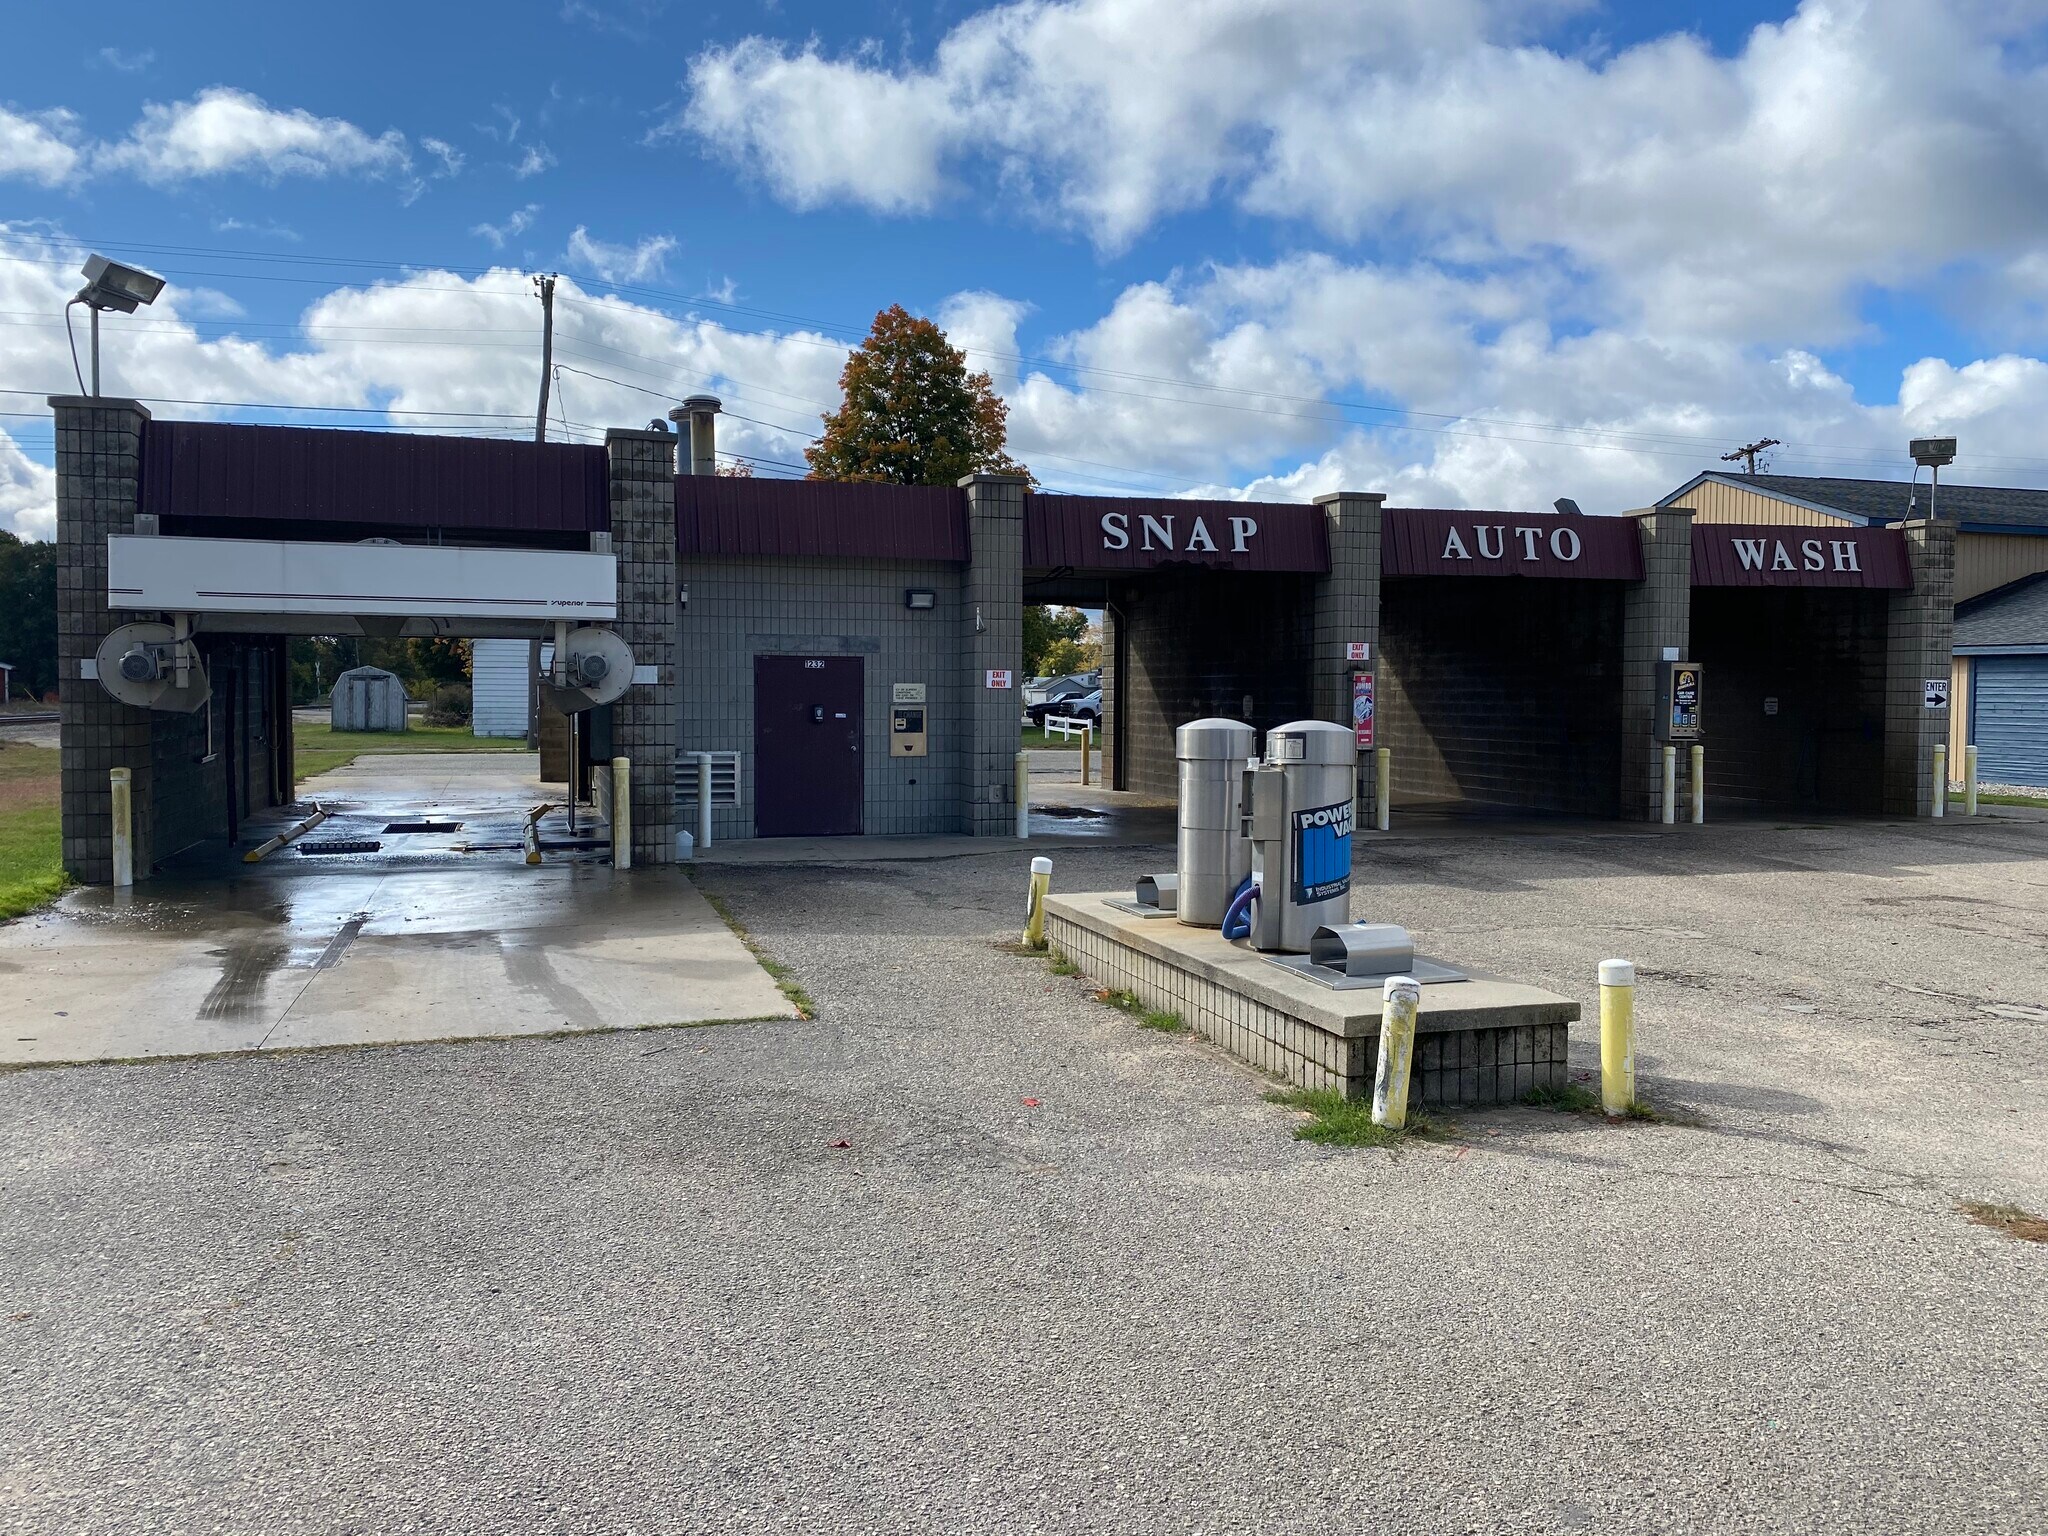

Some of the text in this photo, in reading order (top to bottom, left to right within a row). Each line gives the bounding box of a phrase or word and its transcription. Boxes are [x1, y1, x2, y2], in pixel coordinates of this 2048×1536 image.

[1101, 512, 1258, 552] SNAP
[1441, 525, 1582, 562] AUTO
[1731, 538, 1862, 572] WASH
[1352, 643, 1364, 651] EXIT
[1351, 651, 1364, 659] ONLY
[805, 660, 825, 668] 1232
[992, 671, 1006, 679] EXIT
[991, 680, 1006, 688] ONLY
[1926, 682, 1947, 691] ENTER
[1301, 802, 1352, 829] POWE
[1333, 817, 1352, 837] VA
